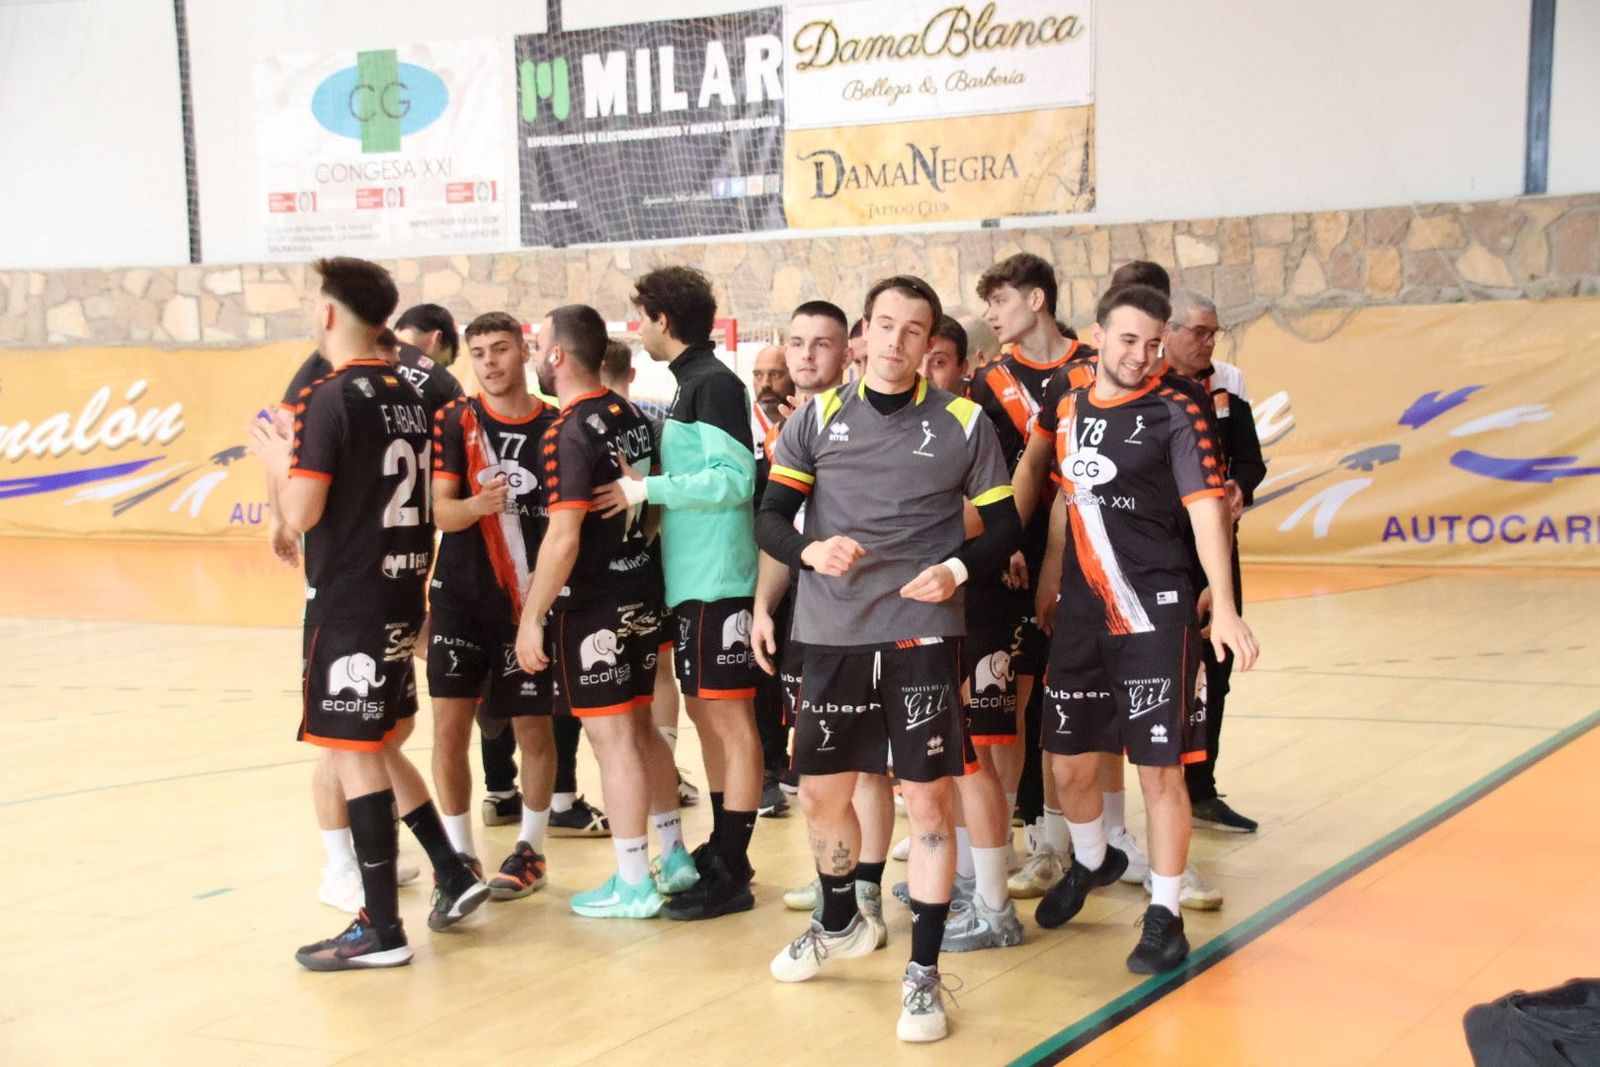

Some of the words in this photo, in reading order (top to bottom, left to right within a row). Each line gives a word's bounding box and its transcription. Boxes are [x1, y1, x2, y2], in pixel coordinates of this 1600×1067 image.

[793, 2, 1085, 71] DamaBlanca
[582, 33, 785, 119] MILAR
[918, 76, 939, 94] &
[348, 81, 411, 122] CG
[315, 160, 417, 184] CONGESA
[422, 158, 453, 178] XXI
[1081, 418, 1107, 445] 78
[499, 432, 528, 460] 77
[1072, 460, 1100, 478] CG
[383, 439, 431, 528] 21
[1111, 496, 1135, 510] XXI
[1381, 515, 1600, 544] AUTOCAR
[801, 700, 882, 713] Pubeer
[904, 684, 949, 725] Gil
[1044, 685, 1111, 700] Pubeer
[1128, 679, 1171, 716] Gil
